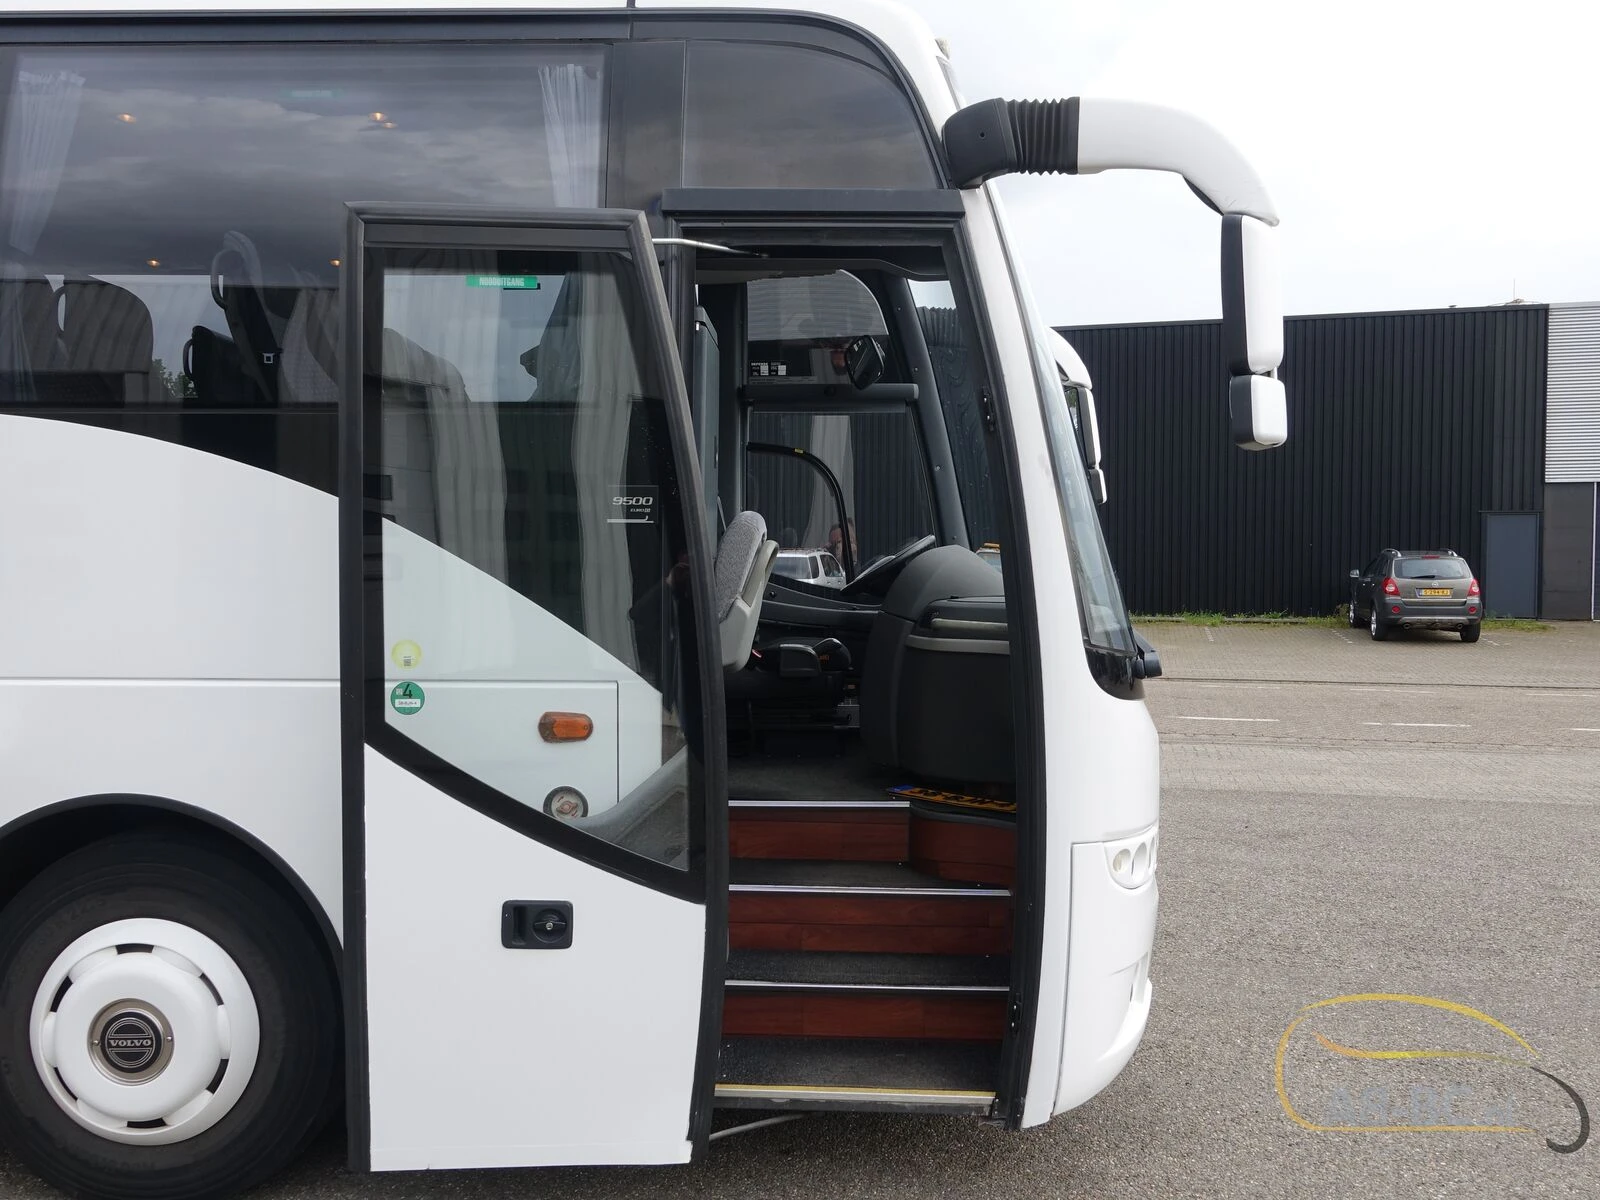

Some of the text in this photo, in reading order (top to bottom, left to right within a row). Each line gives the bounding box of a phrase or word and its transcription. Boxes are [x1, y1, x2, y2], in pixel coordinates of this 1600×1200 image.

[612, 496, 654, 506] 9500
[403, 683, 413, 699] 4
[108, 1038, 152, 1047] VOLVO
